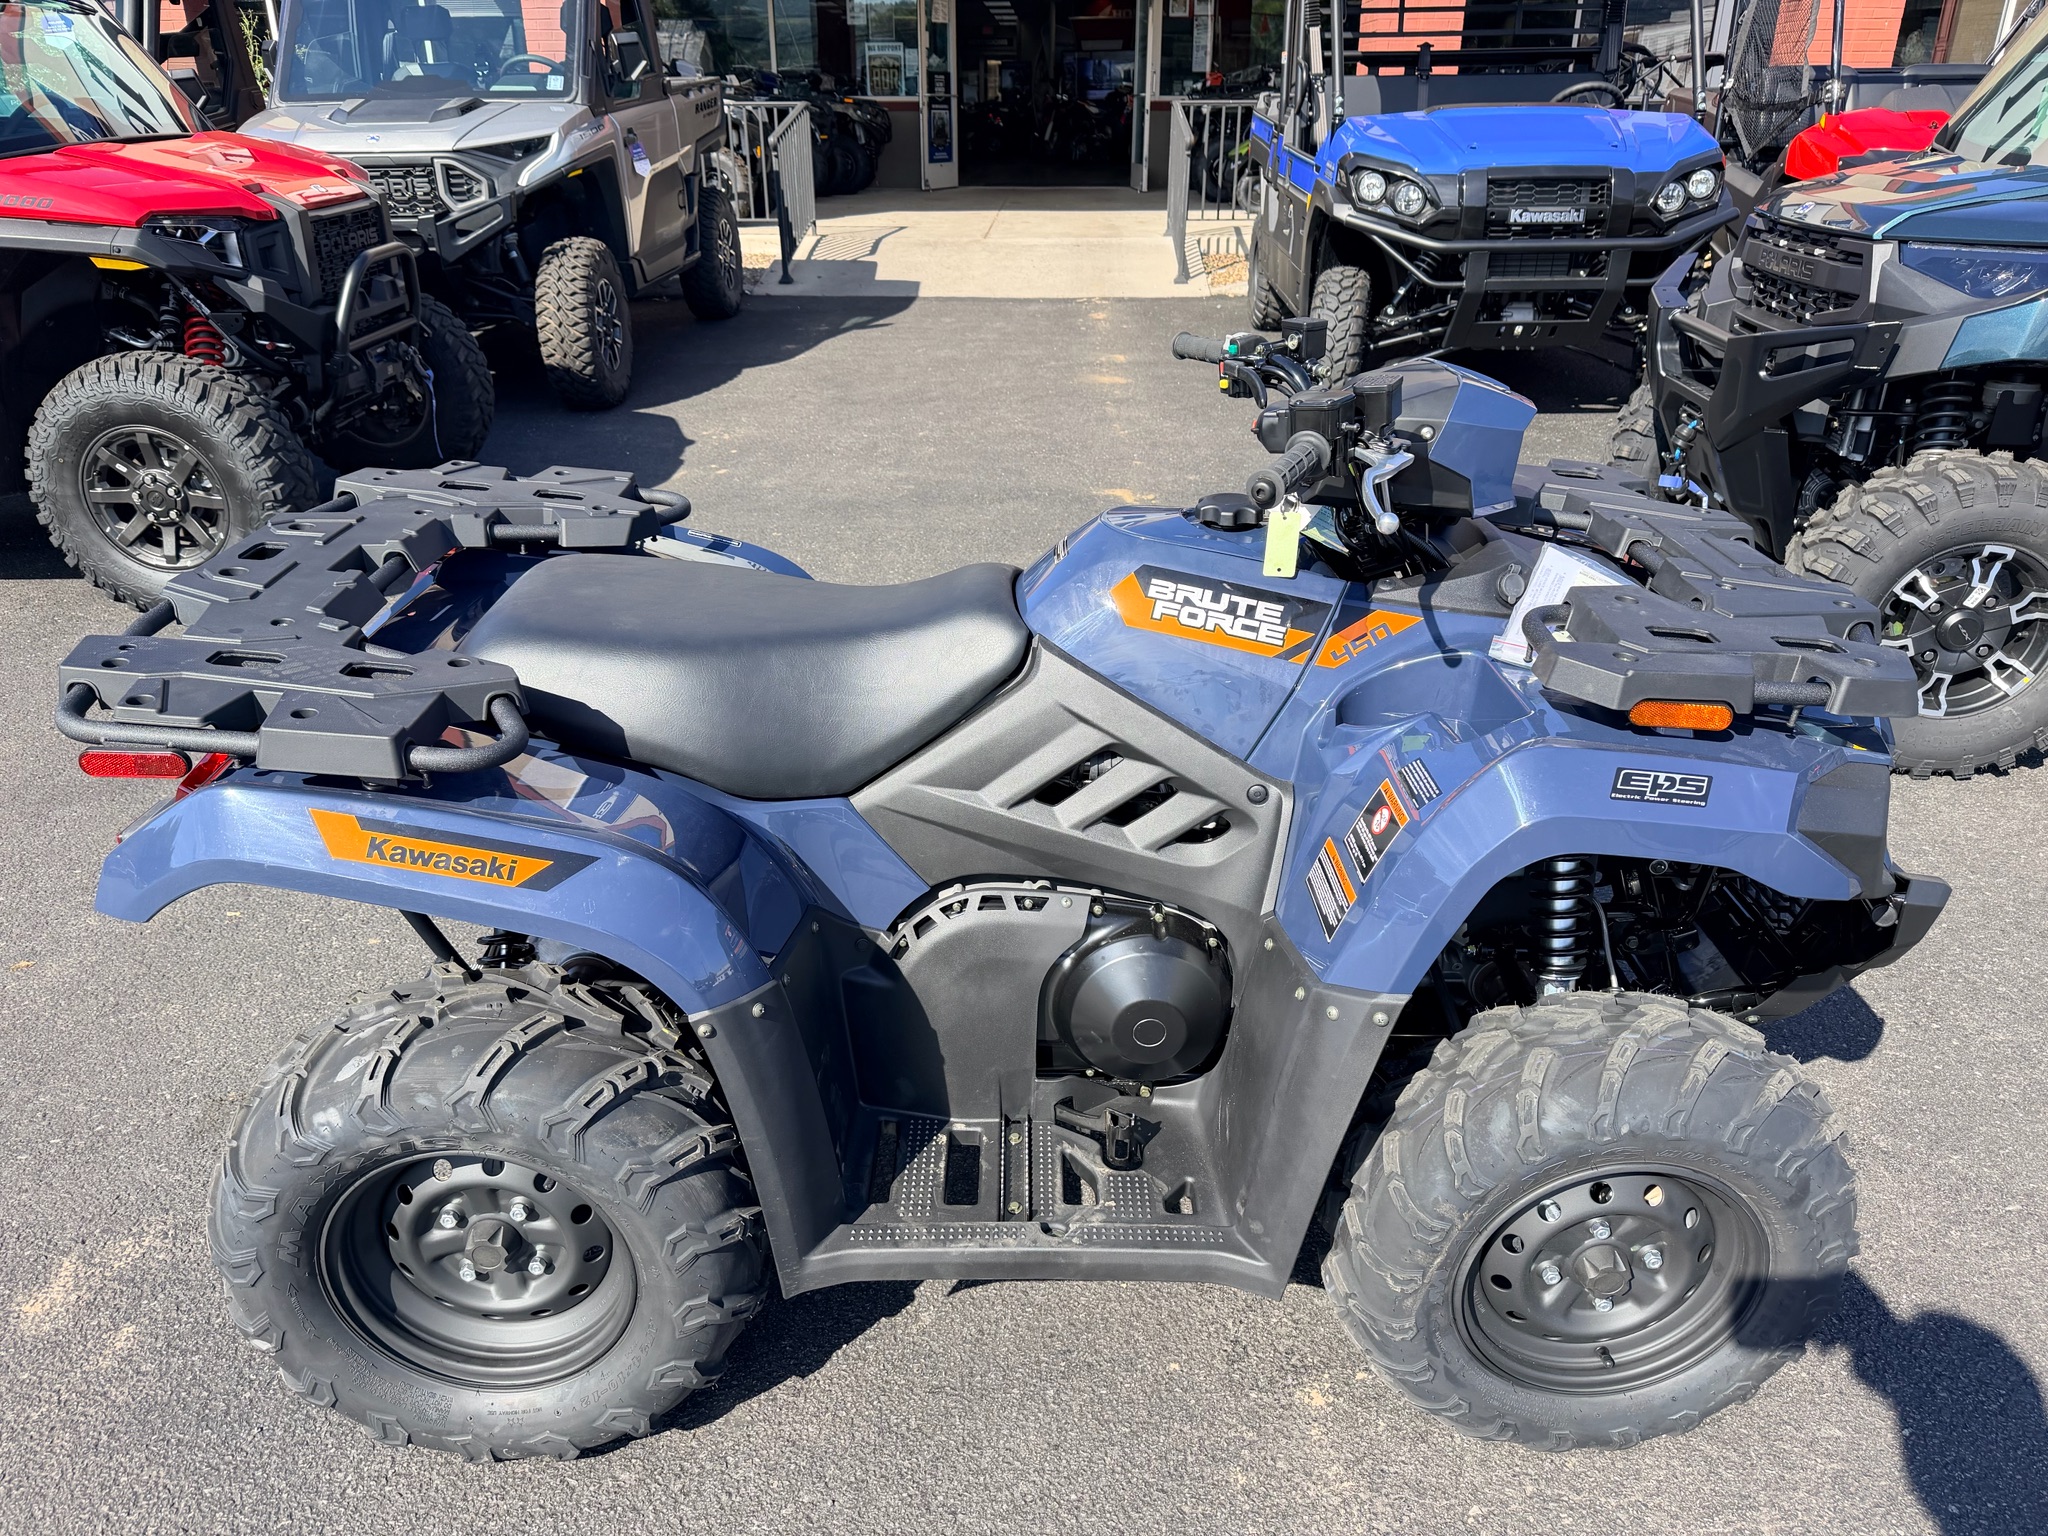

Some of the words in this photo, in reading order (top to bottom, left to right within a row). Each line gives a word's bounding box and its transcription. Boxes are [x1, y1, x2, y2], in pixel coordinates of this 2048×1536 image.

[695, 97, 718, 115] RANGER
[579, 123, 605, 140] 1500
[371, 178, 433, 195] ARIS
[1509, 208, 1585, 223] Kawasaki
[320, 227, 379, 259] POLARIS
[1760, 249, 1815, 280] POLARIS
[1147, 578, 1285, 625] BRUTE
[1151, 600, 1288, 648] FORCE
[1329, 622, 1396, 662] 450
[1388, 789, 1405, 822] WARNING
[1672, 798, 1706, 806] Steering
[365, 836, 518, 882] Kawasaki
[276, 1138, 462, 1267] MAXXIS
